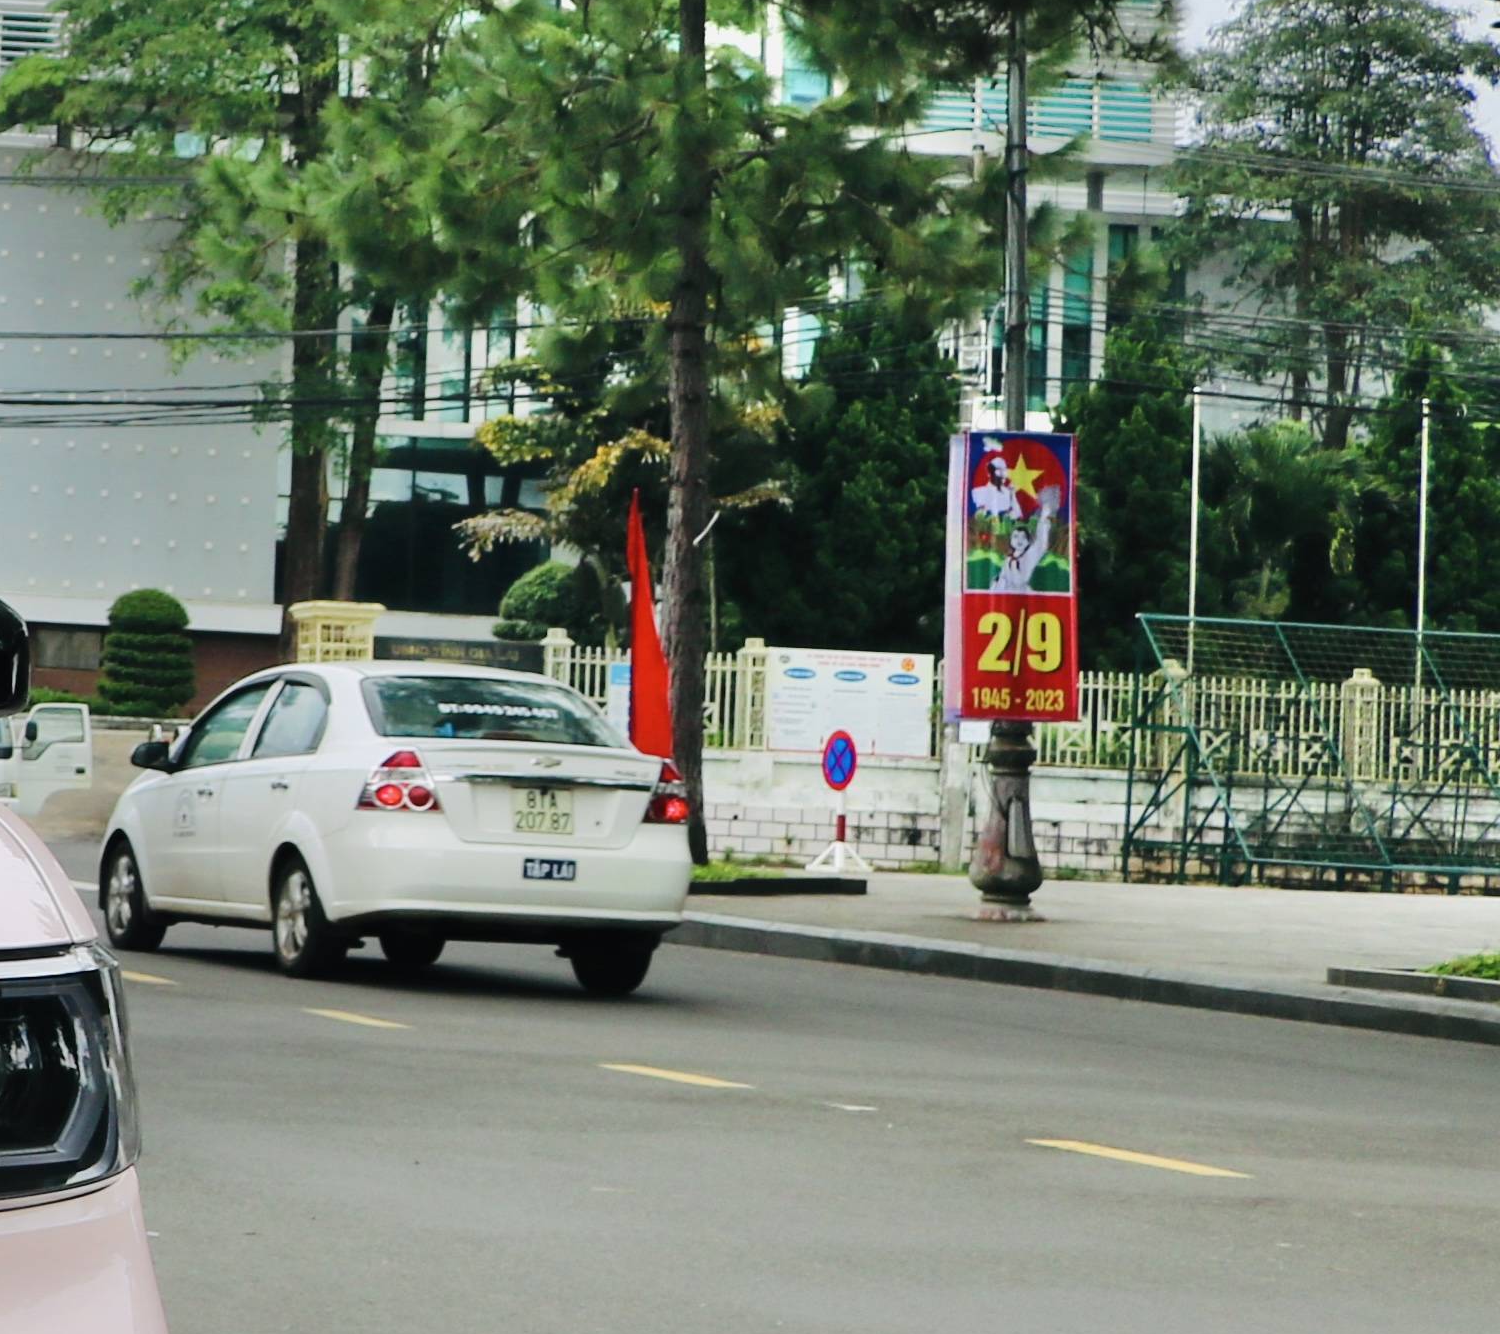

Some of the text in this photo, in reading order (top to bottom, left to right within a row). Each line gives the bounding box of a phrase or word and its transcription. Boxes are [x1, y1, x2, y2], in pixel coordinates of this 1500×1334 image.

[977, 608, 1062, 677] 2/9
[972, 686, 1011, 709] 1945
[1025, 688, 1064, 711] 2023
